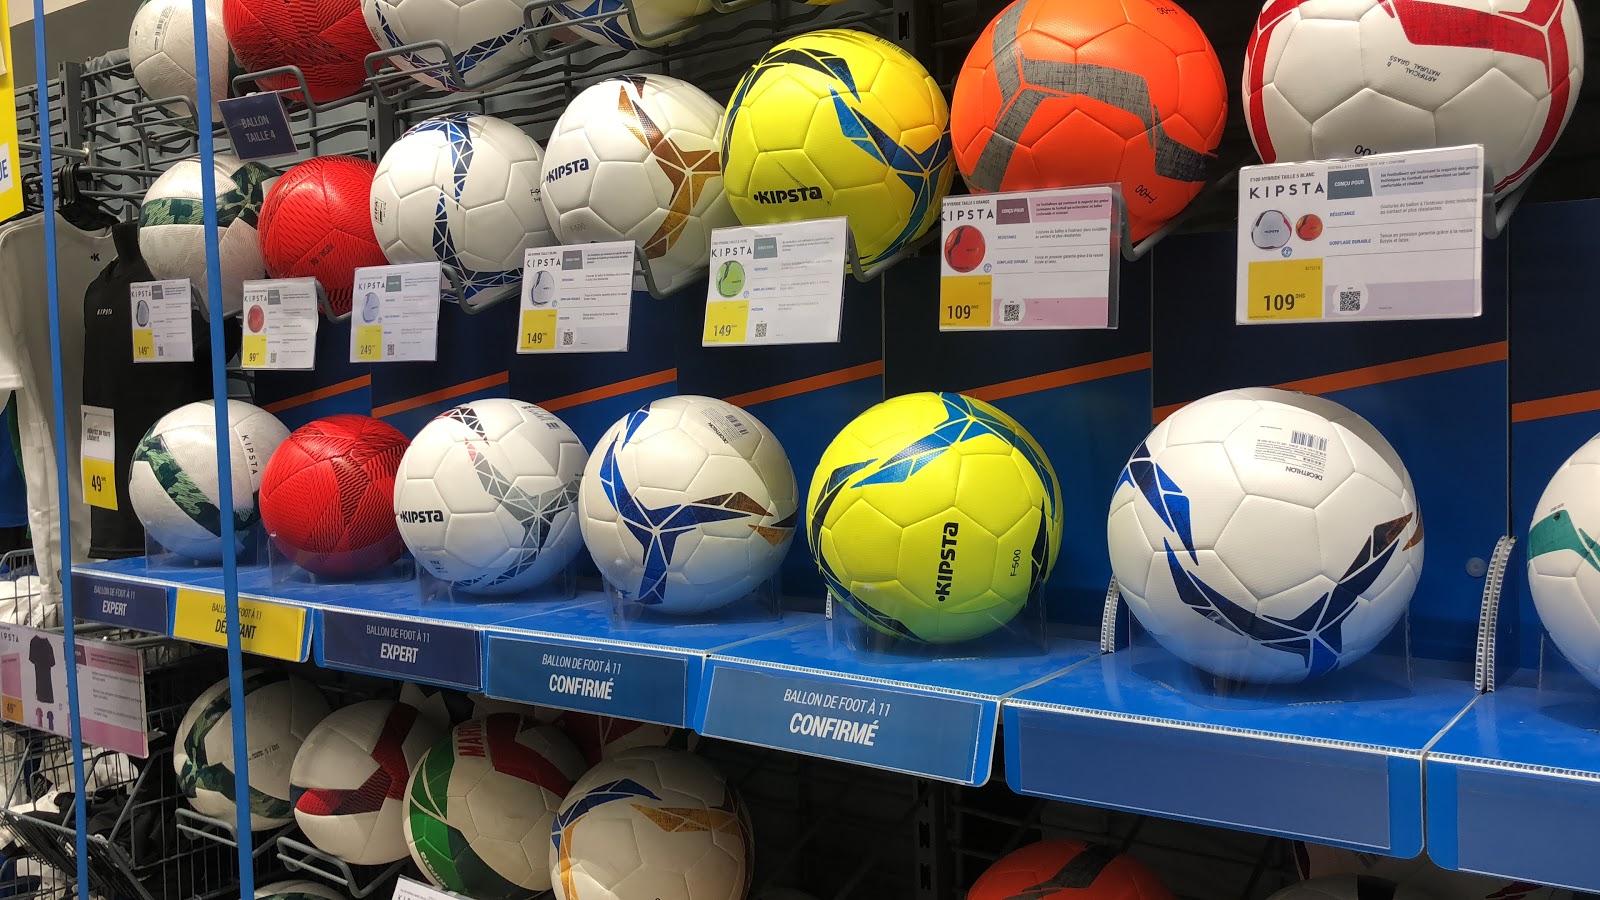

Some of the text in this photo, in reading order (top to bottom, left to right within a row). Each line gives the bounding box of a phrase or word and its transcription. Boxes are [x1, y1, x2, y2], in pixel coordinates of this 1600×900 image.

[1389, 56, 1440, 77] NATURAL GRASS
[1405, 68, 1437, 83] ARTIFICIAL
[241, 115, 270, 128] BALLON
[245, 130, 276, 142] TAILLE 4
[547, 158, 590, 184] KIPSTA
[754, 186, 823, 204] KIPSTA
[1250, 182, 1324, 200] KIPSTA
[711, 246, 752, 258] KIPSTA
[527, 258, 561, 268] KIPSTA
[358, 282, 385, 290] KIPSTA
[1264, 294, 1295, 311] 109
[948, 305, 971, 319] 109
[714, 325, 731, 336] 149
[527, 333, 542, 344] 149
[138, 346, 147, 356] 149
[360, 345, 372, 354] 249
[249, 353, 256, 362] 99
[241, 434, 257, 475] KIPSTA
[1285, 466, 1323, 481] DECATHLON
[92, 475, 102, 492] 49
[400, 510, 444, 523] KIPSTA
[935, 522, 958, 602] KIPSTA
[94, 585, 109, 595] BALLON
[110, 588, 115, 596] DE
[115, 589, 126, 598] FOOT
[102, 600, 128, 616] EXPERT
[212, 603, 226, 613] BALLO
[215, 617, 257, 639] DÉANT
[366, 625, 430, 643] BALLON DE FOOT À 11
[1, 632, 19, 643] IPSTA
[380, 643, 419, 664] EXPERT
[542, 654, 621, 675] BALLON DE FOOT À 11
[549, 674, 614, 700] CONFIRMÉ
[784, 688, 891, 717] BALLON DE FOOT À 11
[789, 712, 879, 746] CONFIRMÉ
